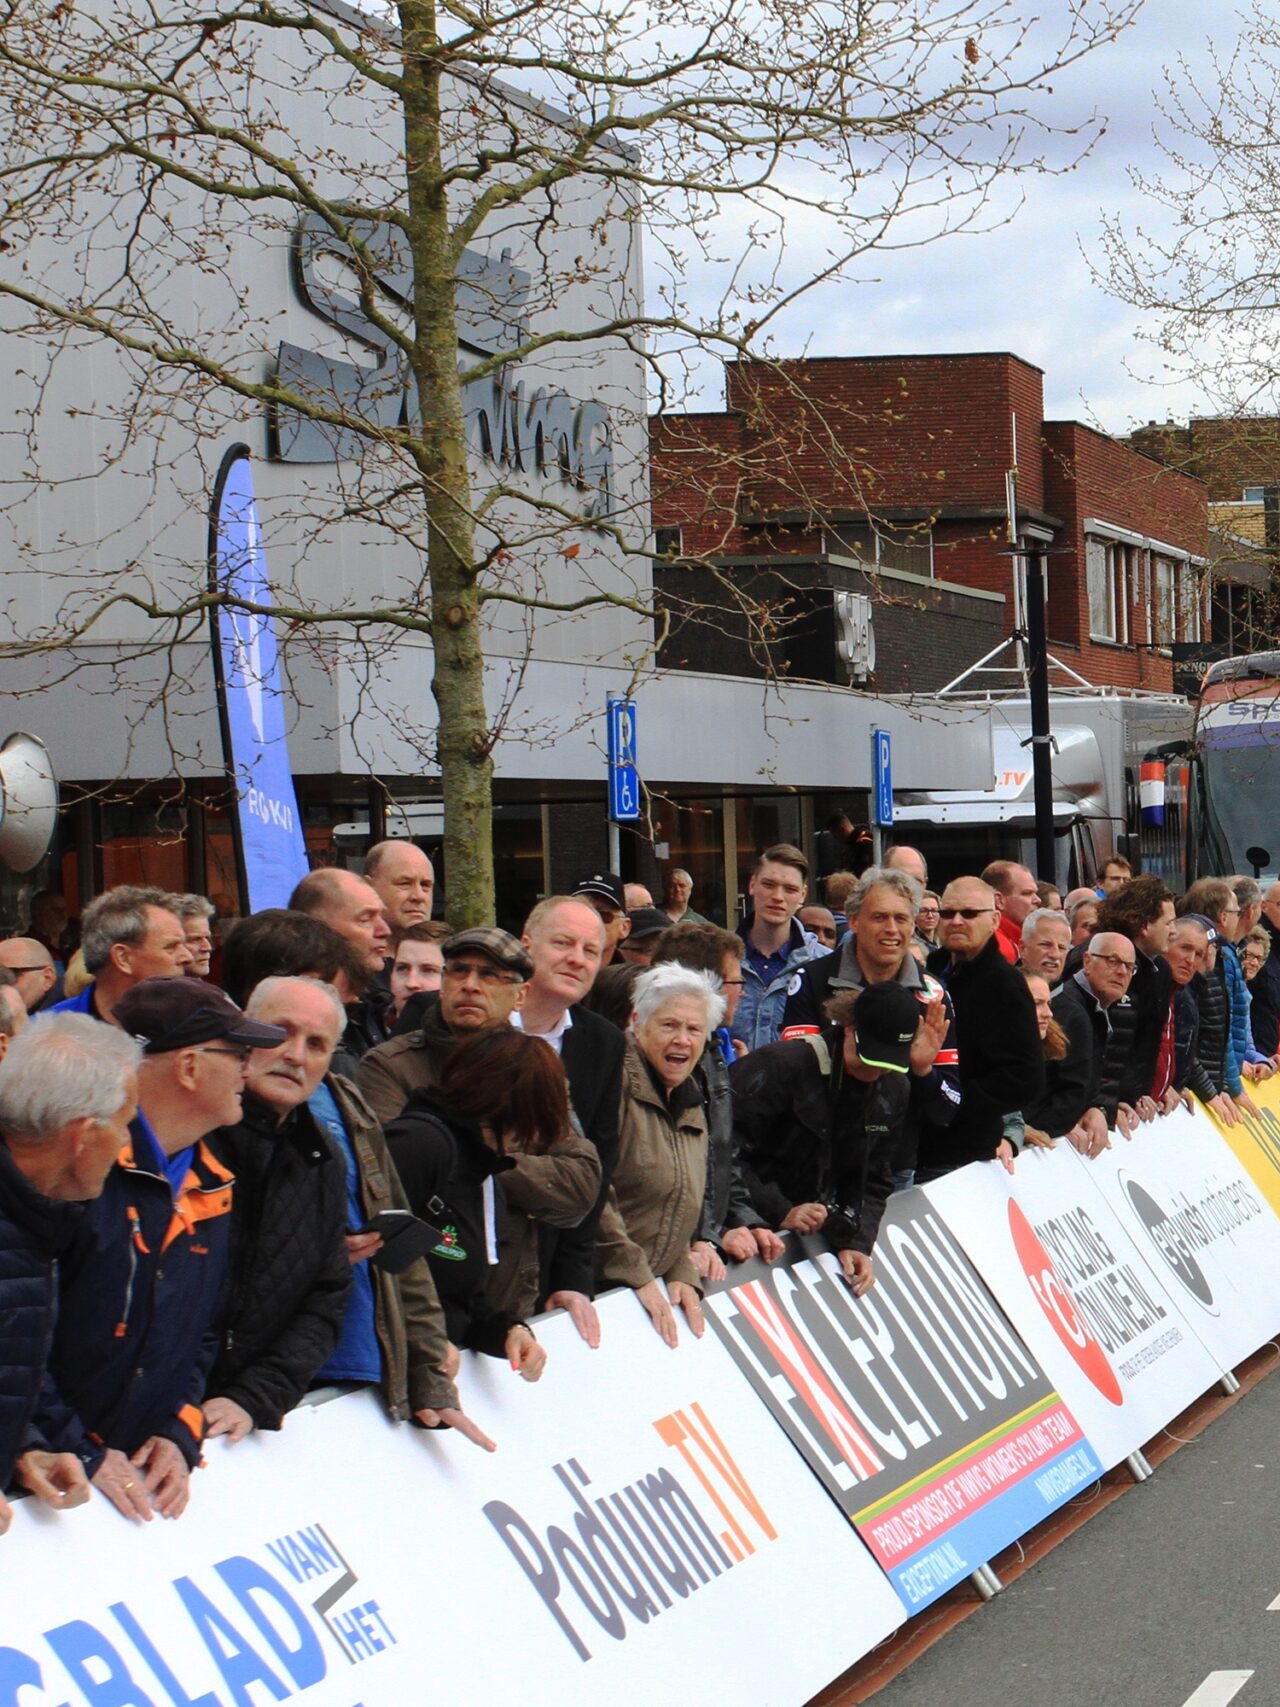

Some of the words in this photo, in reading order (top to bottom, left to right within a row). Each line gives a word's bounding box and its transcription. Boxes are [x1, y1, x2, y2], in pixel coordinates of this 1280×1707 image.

[900, 1486, 957, 1540] SPONSOR
[942, 1478, 969, 1512] OF
[1041, 1408, 1075, 1445] TEAM
[265, 1523, 338, 1584] VAN
[481, 1401, 779, 1664] Podium.TV
[897, 1537, 968, 1604] EXCEPTION.NL
[332, 1600, 398, 1662] HET
